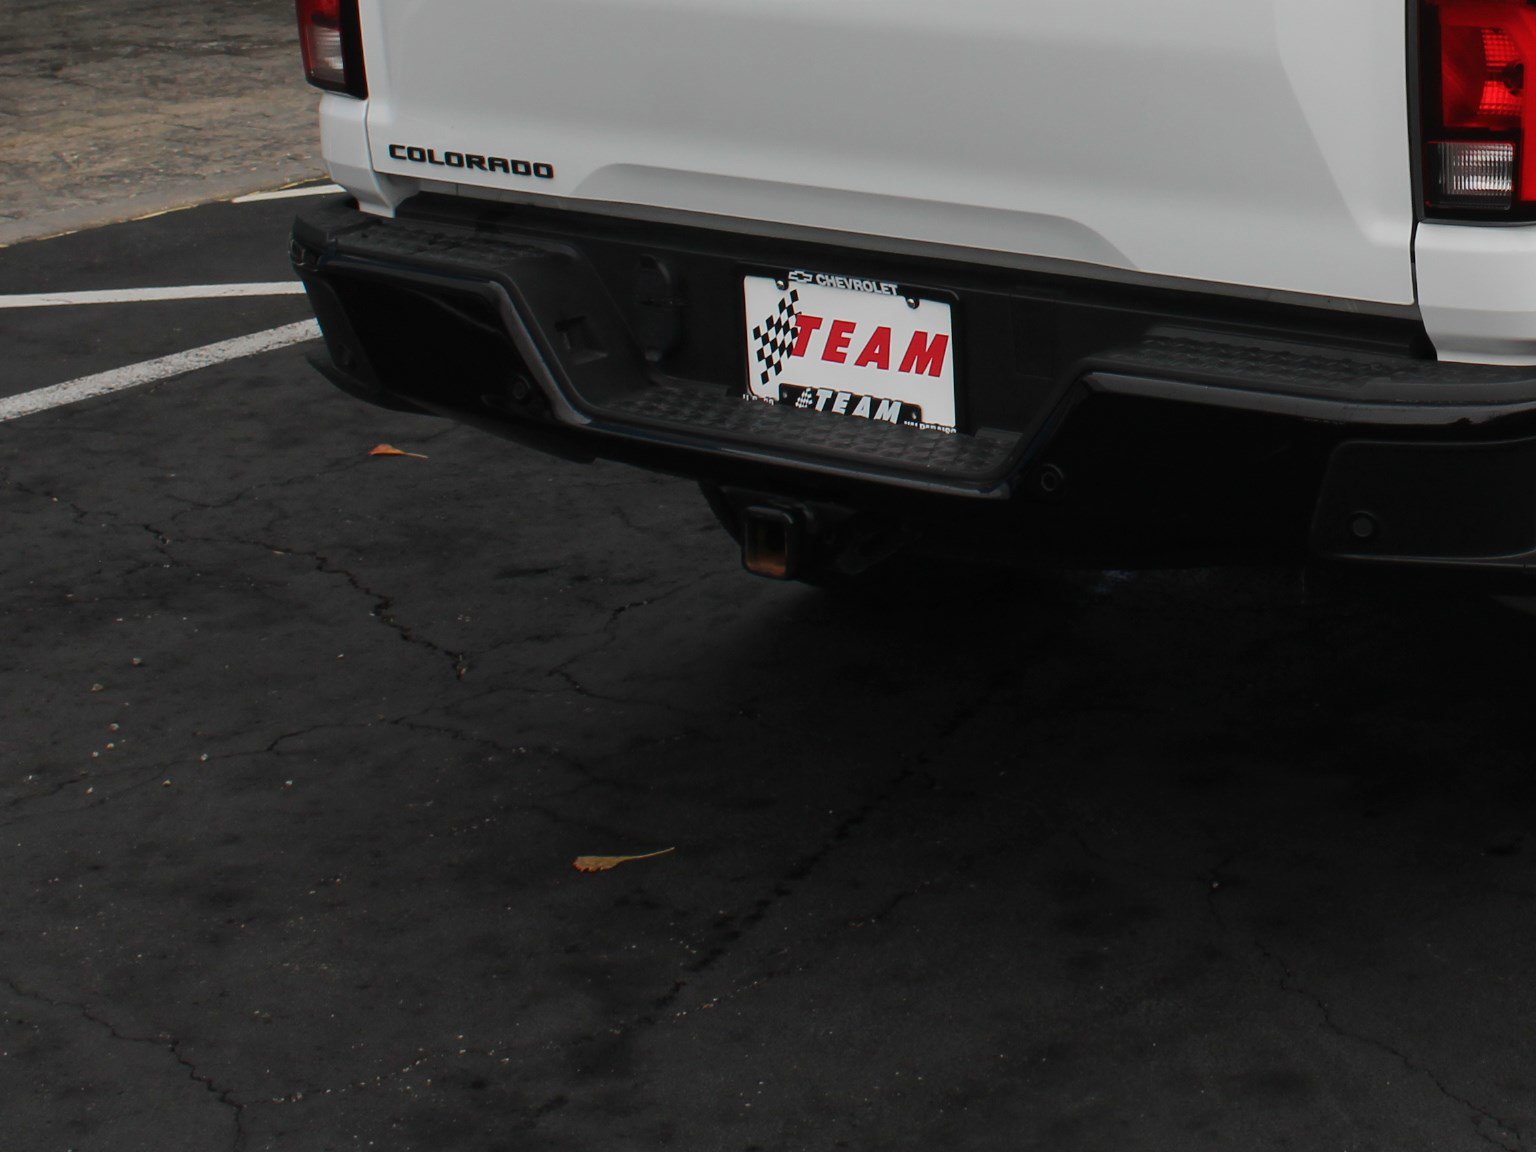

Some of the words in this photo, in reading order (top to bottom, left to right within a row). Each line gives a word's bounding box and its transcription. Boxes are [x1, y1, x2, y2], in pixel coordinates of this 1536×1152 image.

[388, 143, 554, 180] COLORADO
[815, 273, 898, 296] CHEVROLET
[791, 313, 949, 378] TEAM
[814, 389, 902, 425] TEAM
